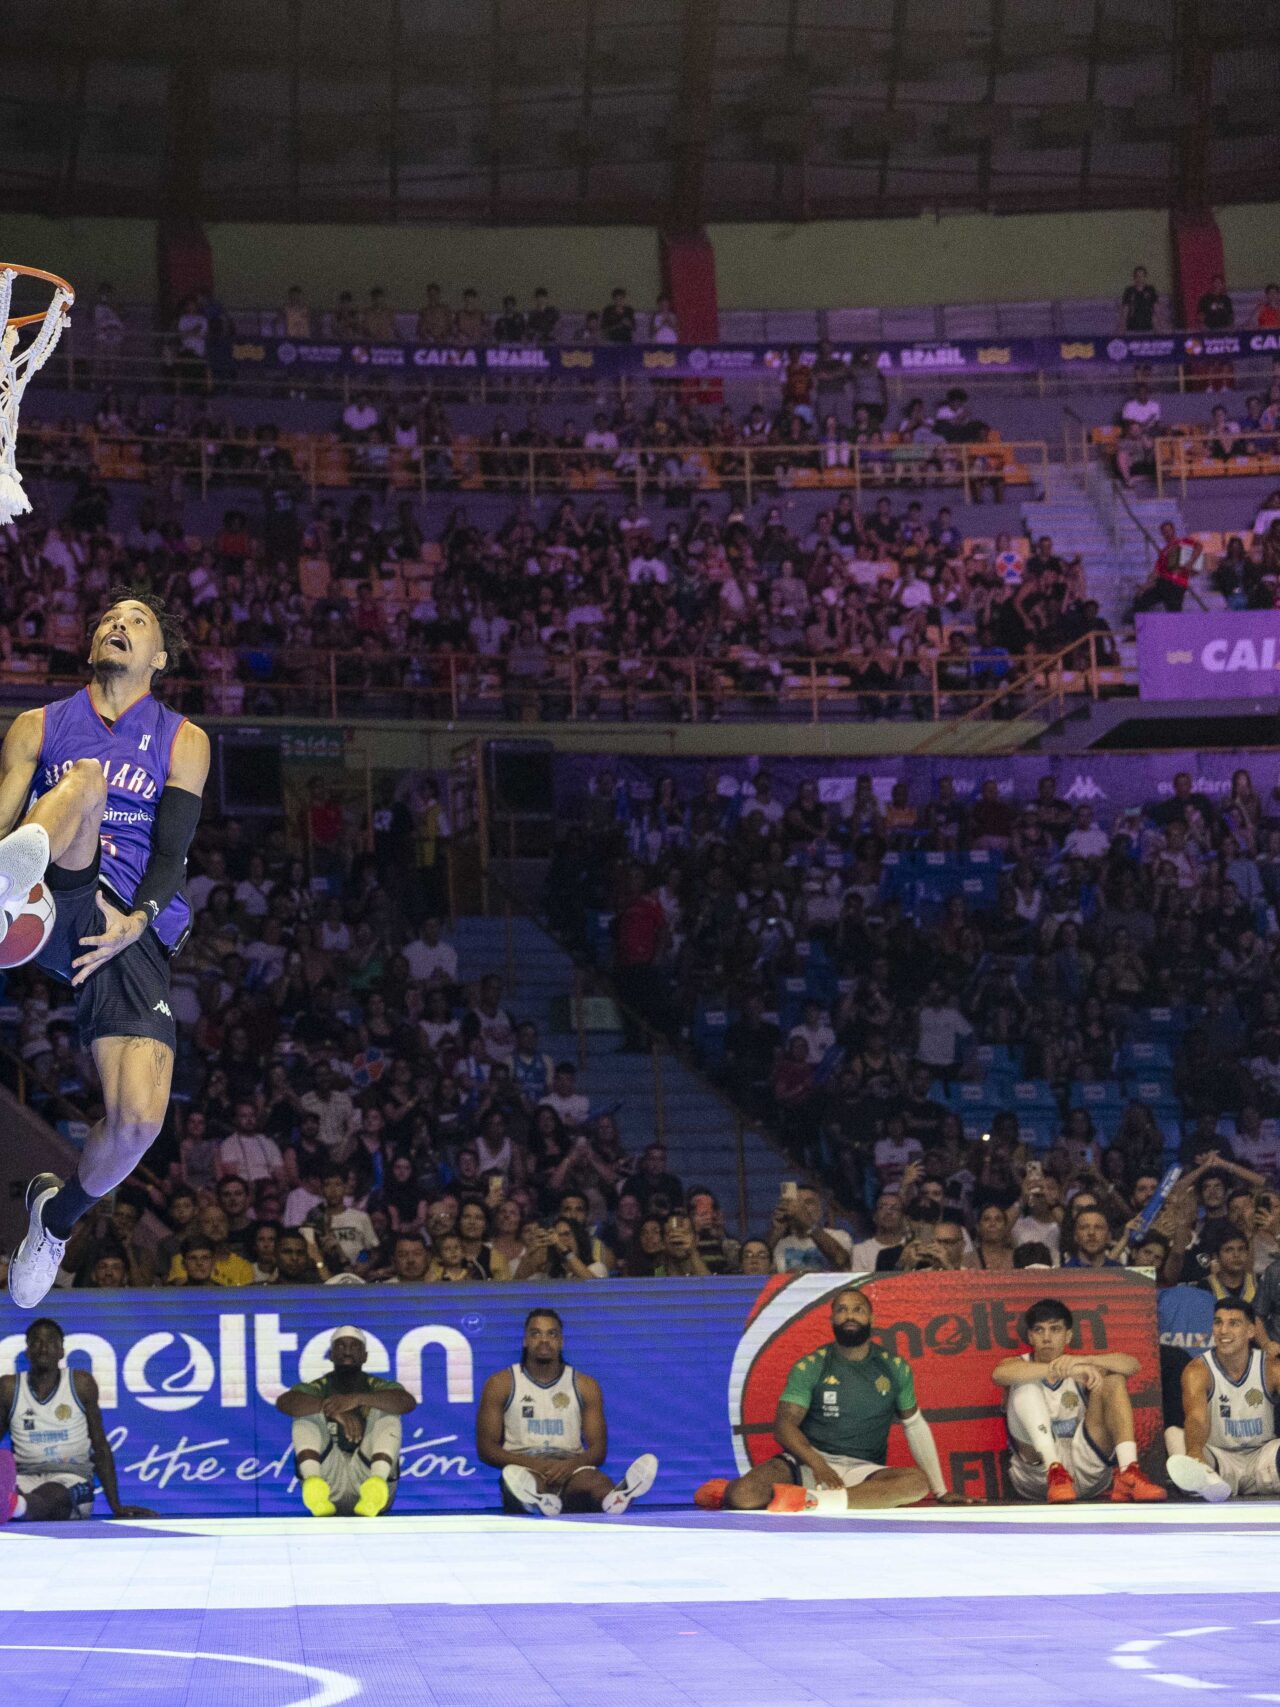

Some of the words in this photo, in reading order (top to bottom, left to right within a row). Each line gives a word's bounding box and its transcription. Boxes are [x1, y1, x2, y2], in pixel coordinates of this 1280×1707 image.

[413, 349, 477, 367] CAIXA
[1201, 637, 1280, 672] CAI
[124, 1436, 230, 1489] the
